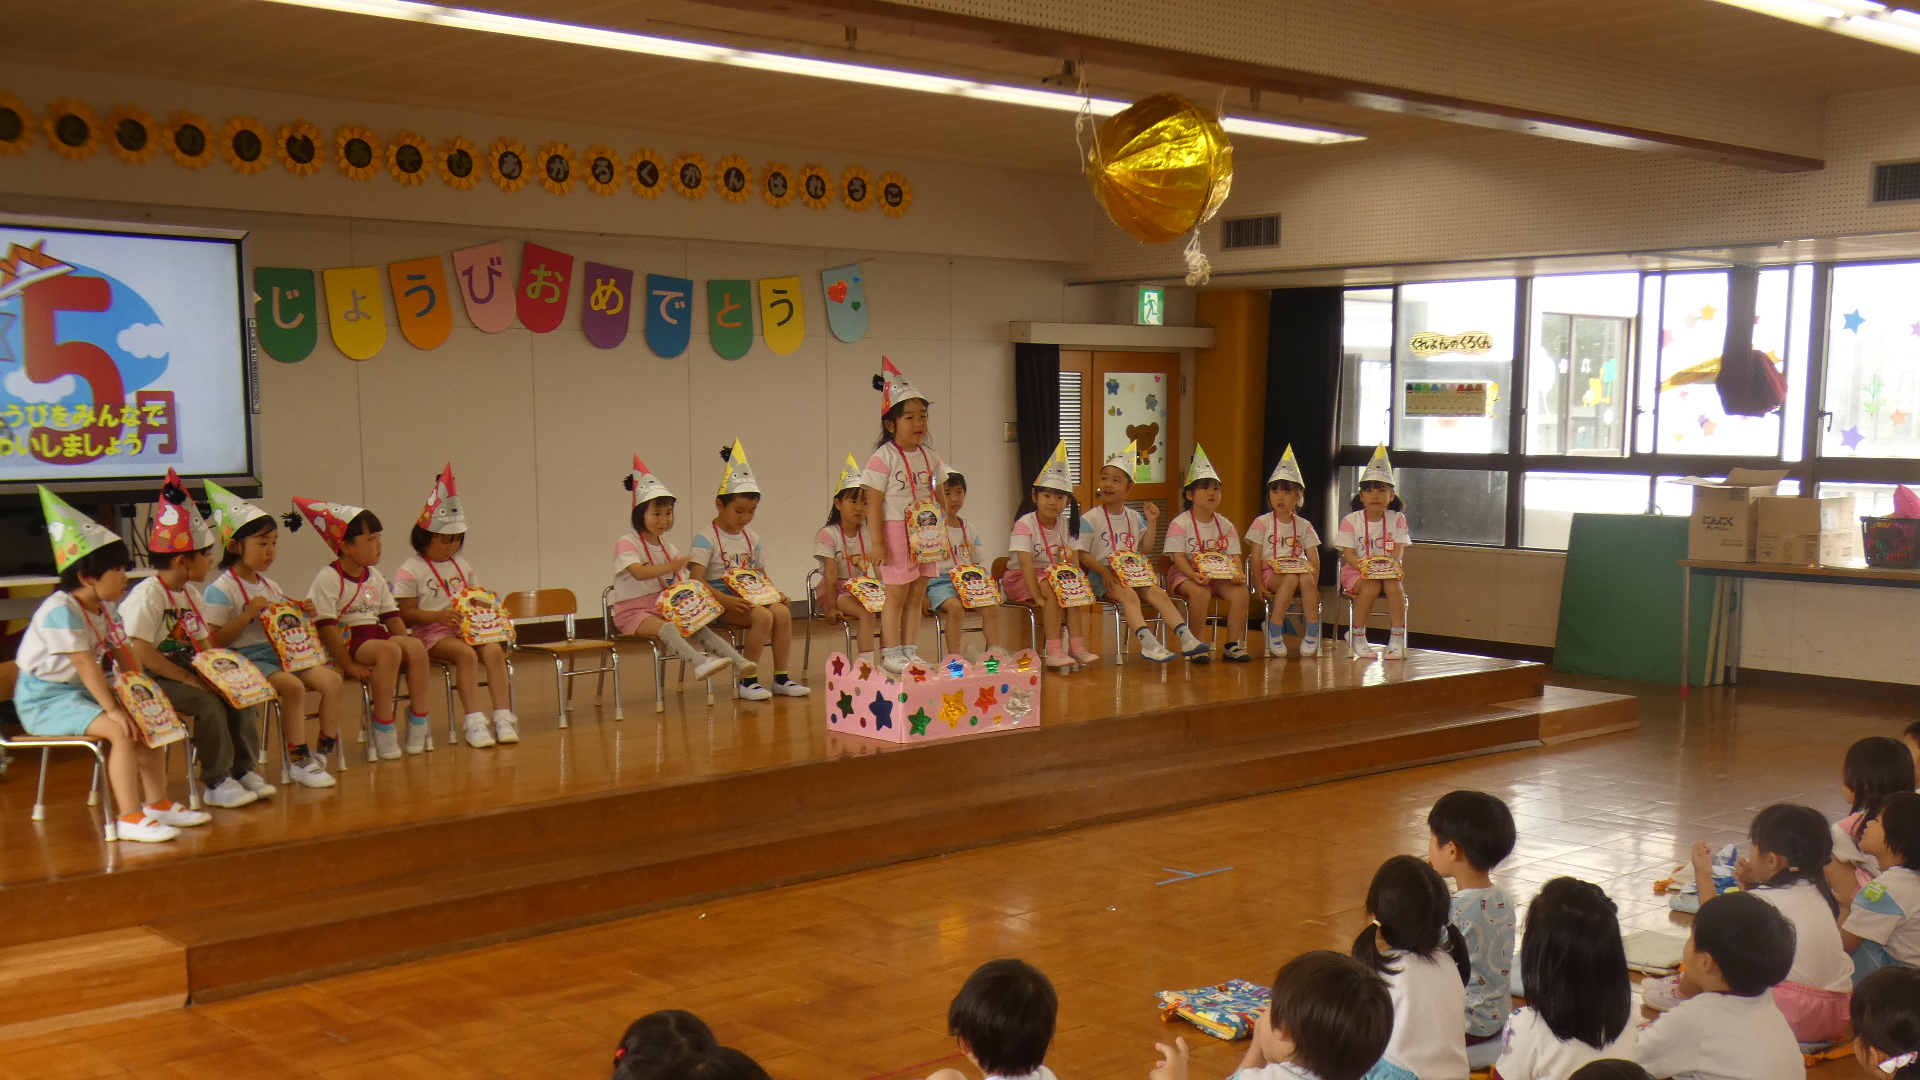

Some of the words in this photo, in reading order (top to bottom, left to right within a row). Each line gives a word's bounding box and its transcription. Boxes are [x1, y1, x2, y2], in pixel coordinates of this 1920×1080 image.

[0, 404, 167, 428] うびをみんなで
